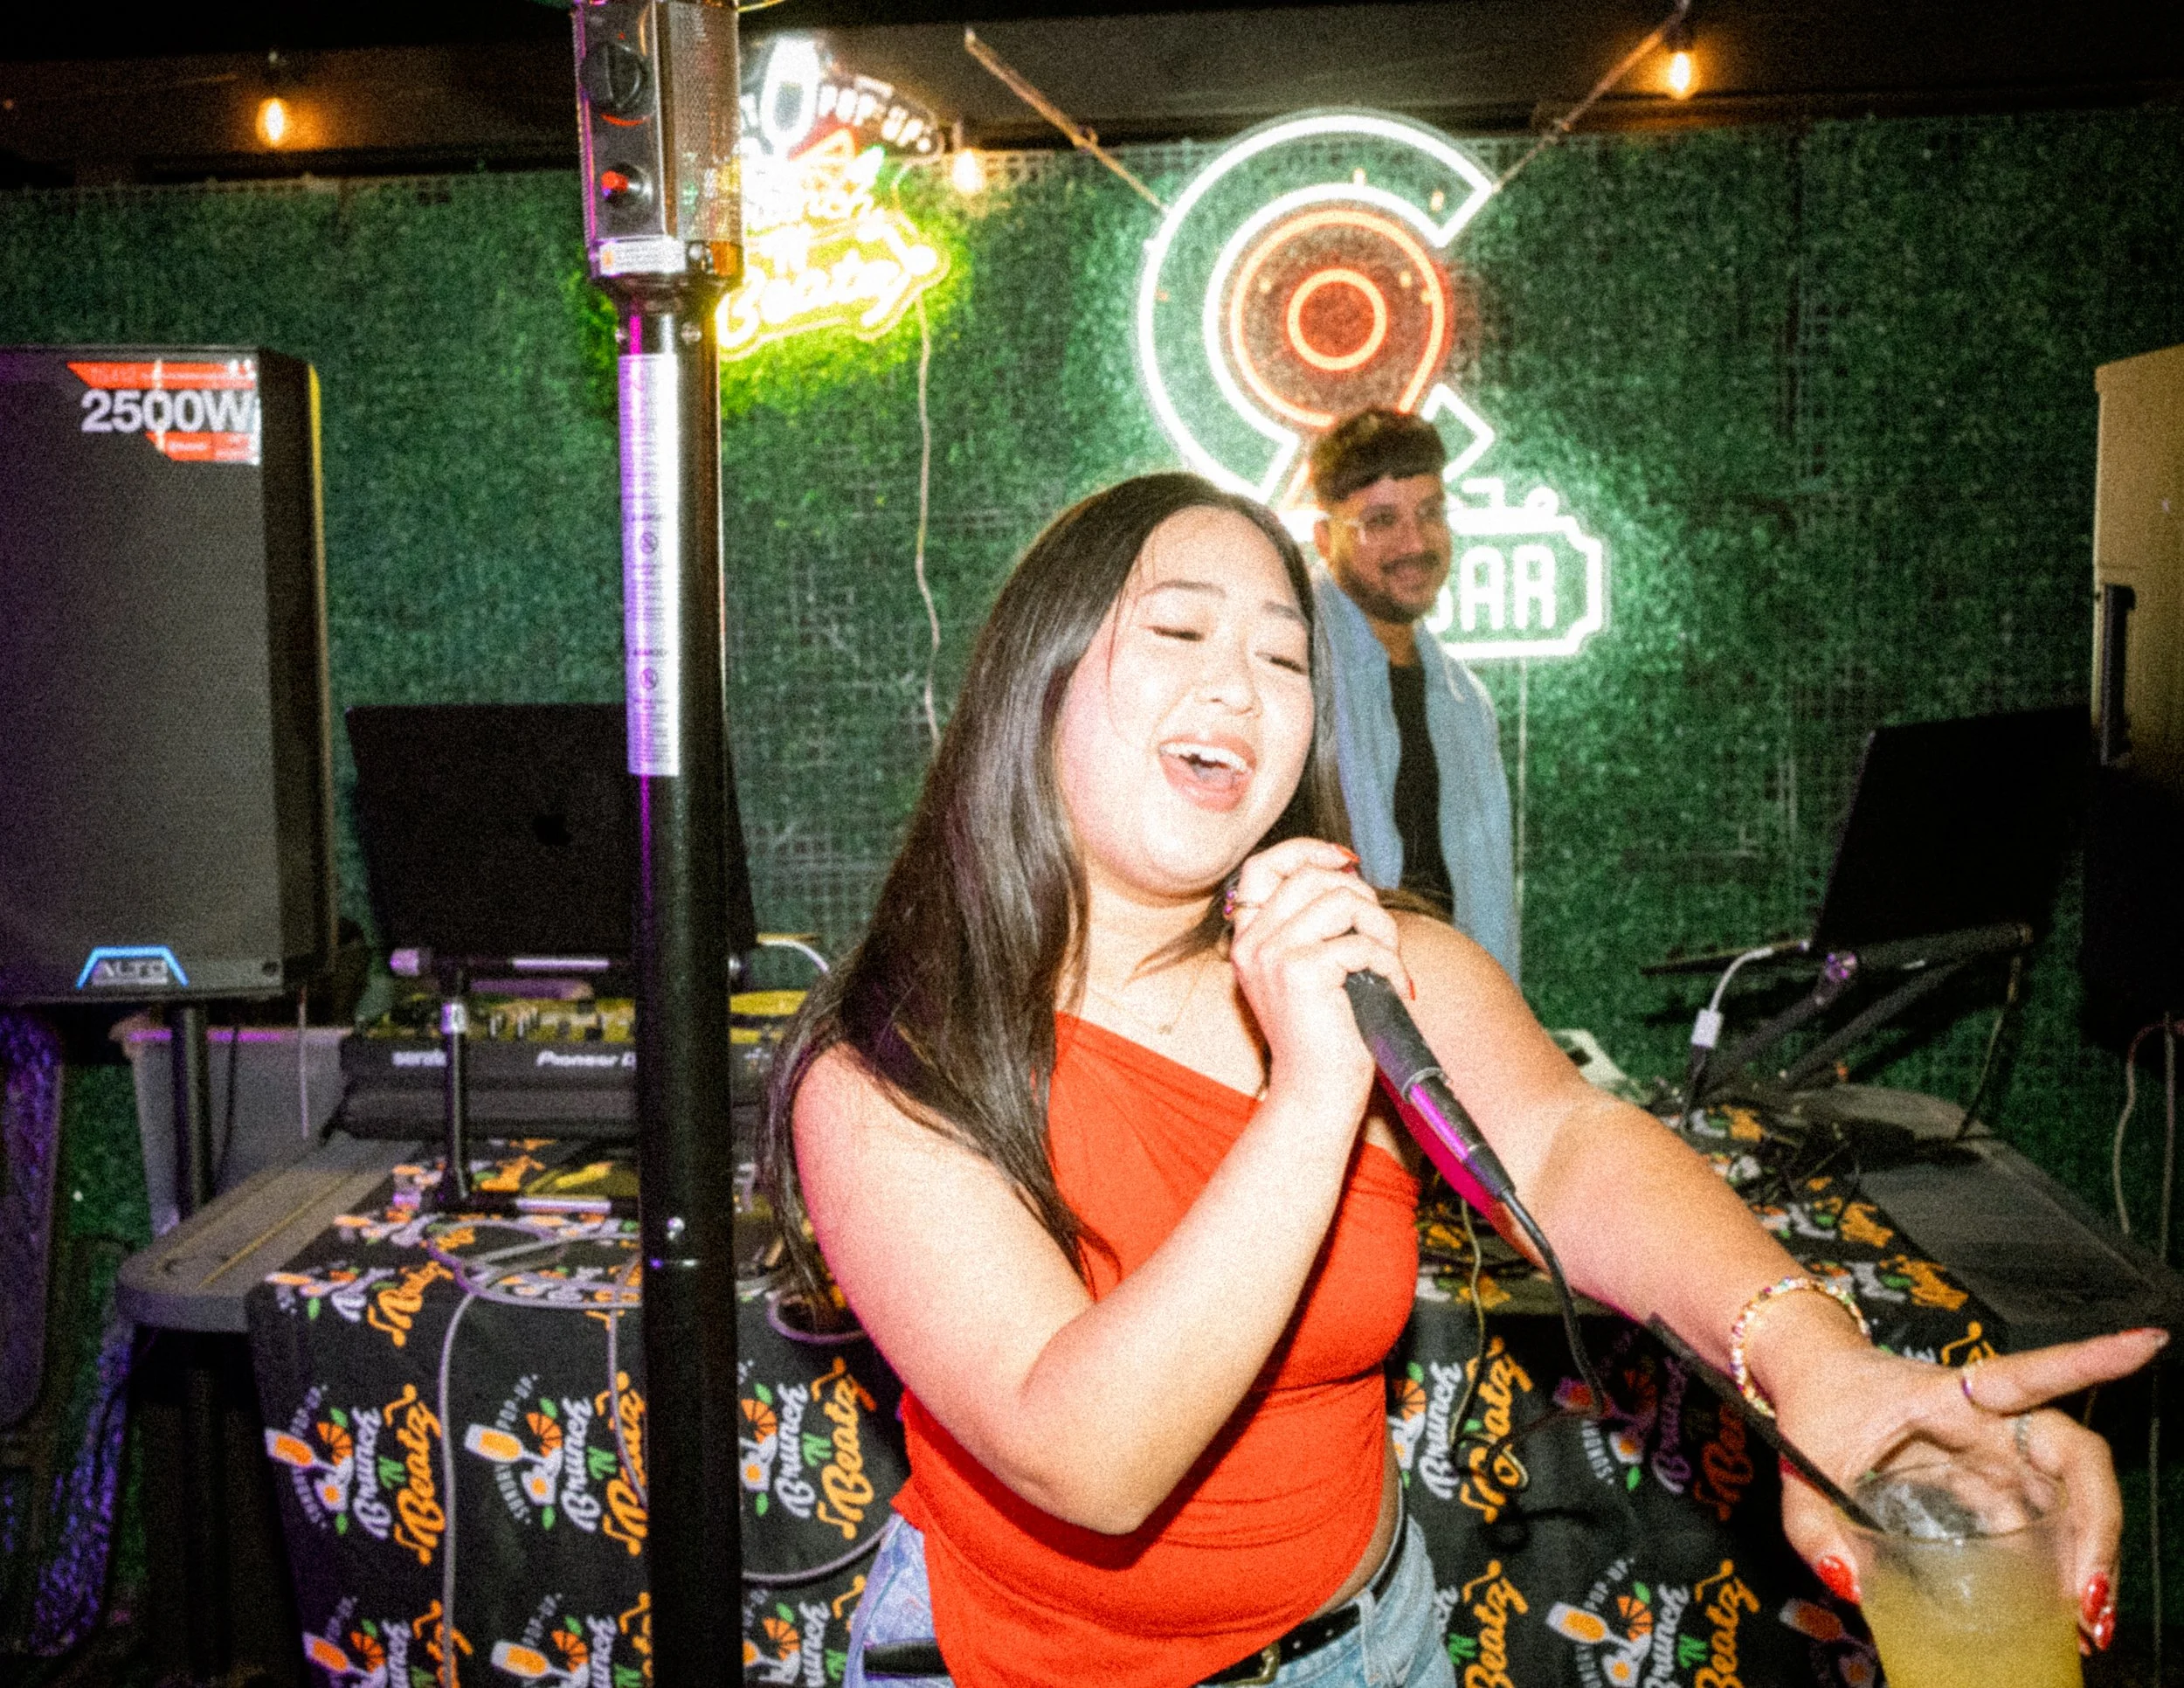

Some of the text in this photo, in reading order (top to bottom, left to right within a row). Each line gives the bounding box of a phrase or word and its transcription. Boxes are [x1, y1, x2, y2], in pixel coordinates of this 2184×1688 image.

[81, 390, 255, 432] 2500W
[350, 1406, 392, 1539] Brunch
[397, 1401, 446, 1549] Beatz
[561, 1395, 602, 1532] Brunch
[773, 1382, 816, 1519] Brunch
[820, 1373, 877, 1523] Beatz
[1418, 1361, 1462, 1499] Brunch
[1468, 1352, 1533, 1506] Batz
[1701, 1403, 1756, 1504] Bea
[380, 1619, 412, 1688] unch
[585, 1615, 618, 1688] unch
[798, 1601, 831, 1688] unch
